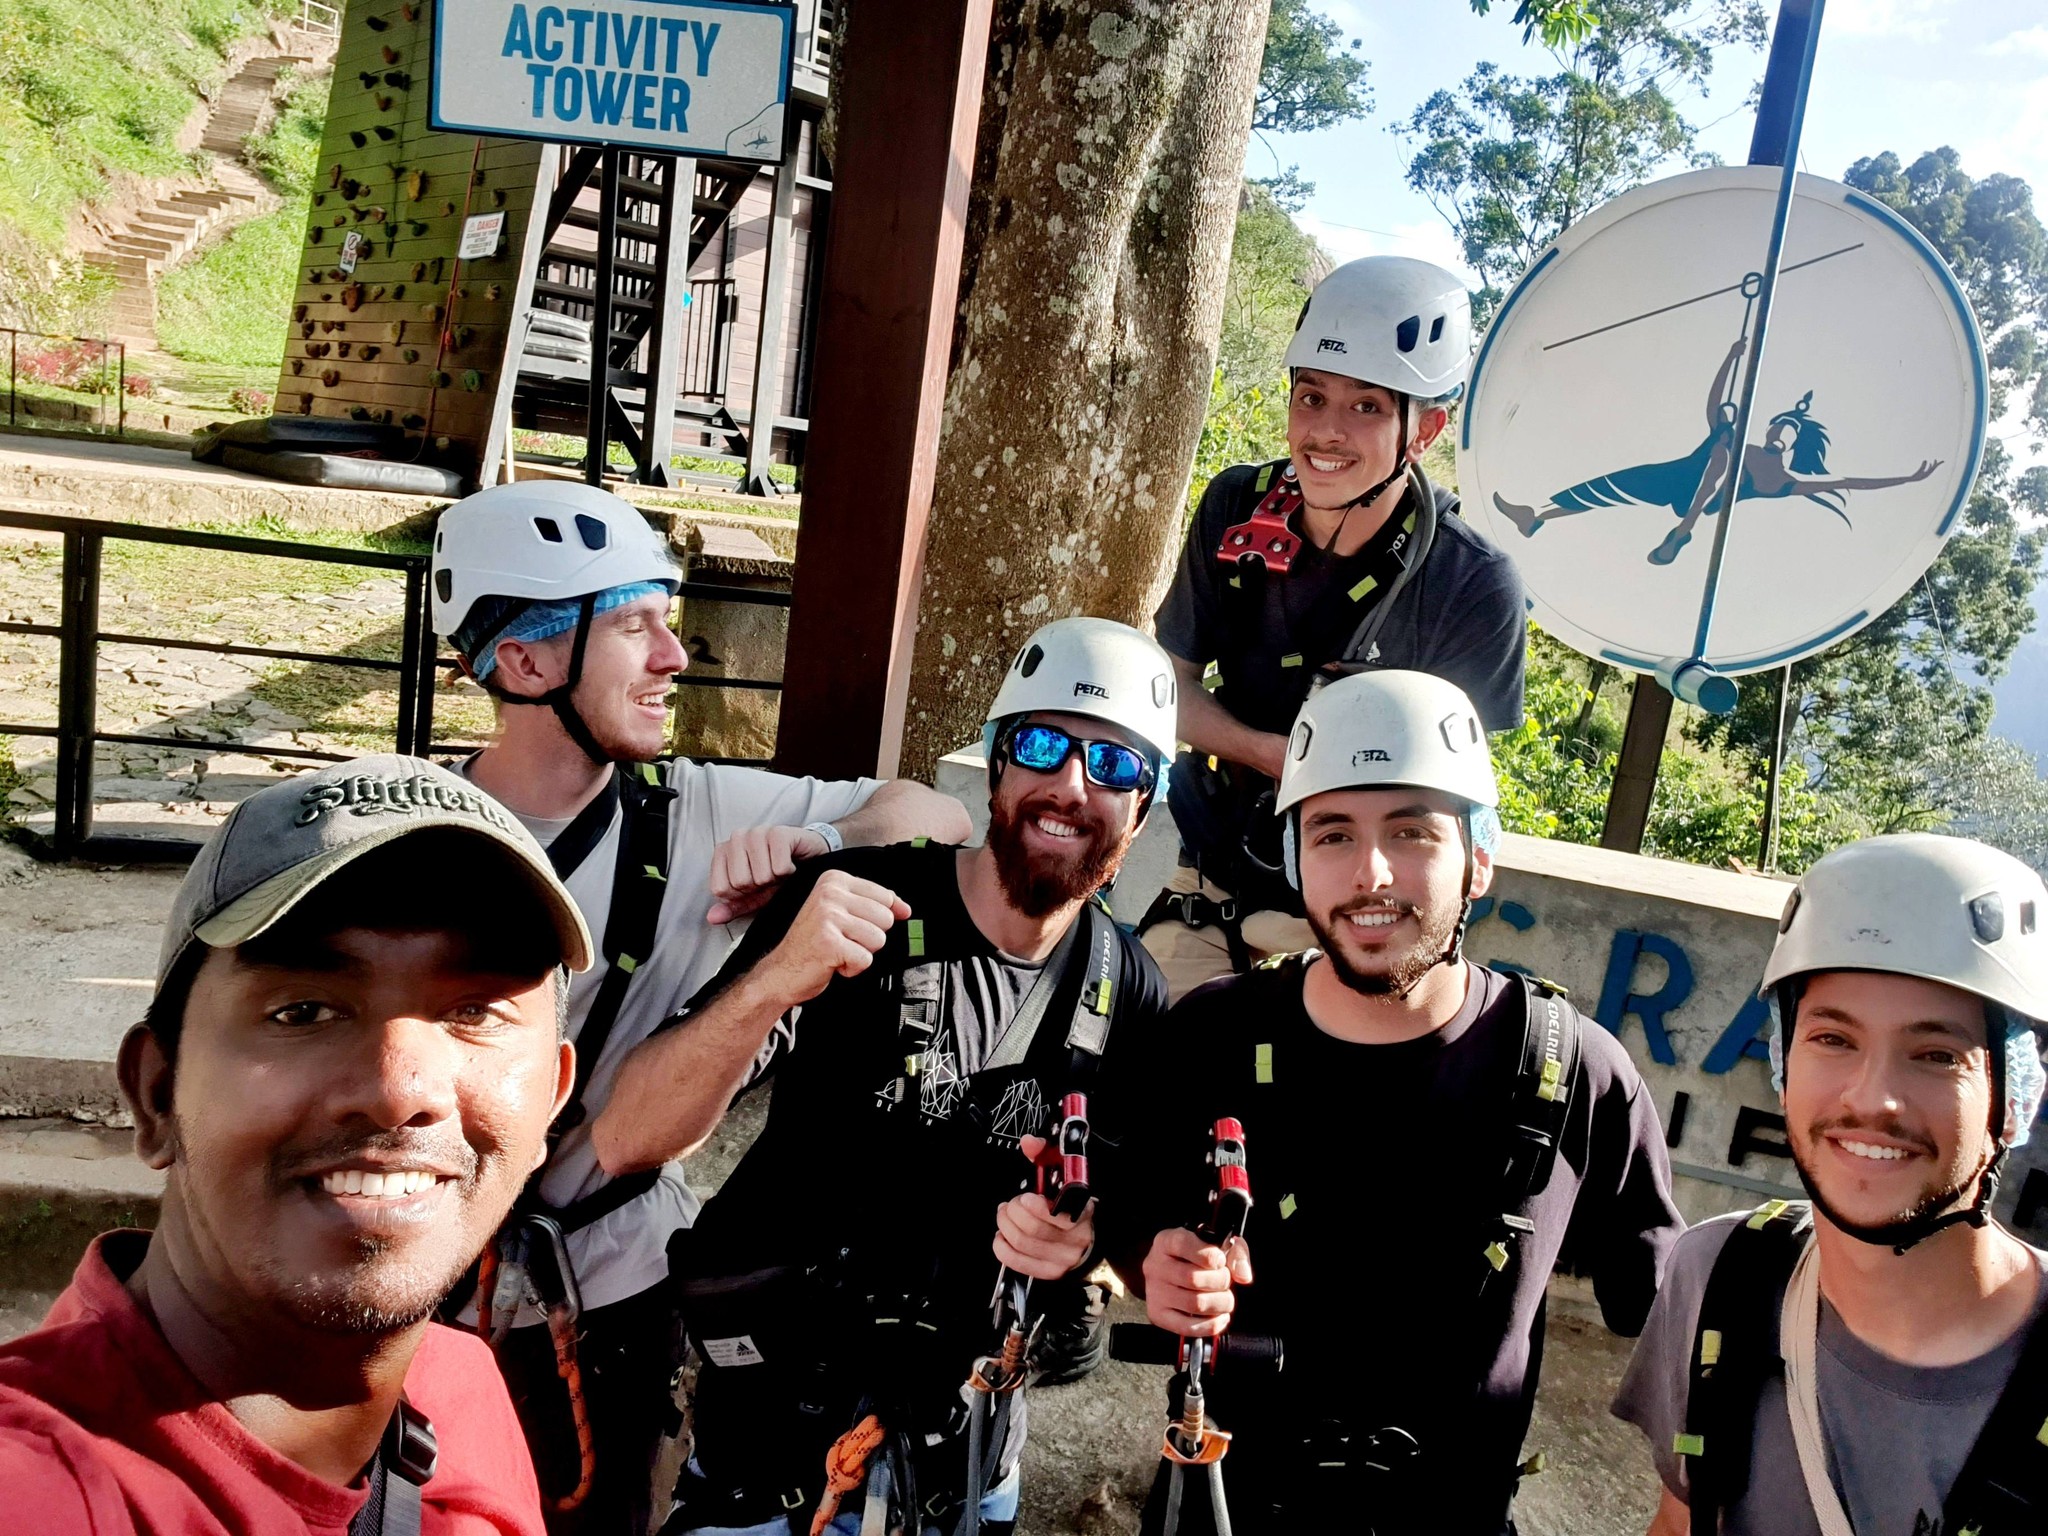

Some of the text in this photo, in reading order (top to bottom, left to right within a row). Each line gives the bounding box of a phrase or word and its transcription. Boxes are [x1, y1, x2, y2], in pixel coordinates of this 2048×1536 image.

[501, 3, 721, 77] ACTIVITY
[526, 63, 690, 133] TOWER
[1073, 682, 1110, 699] PETZL
